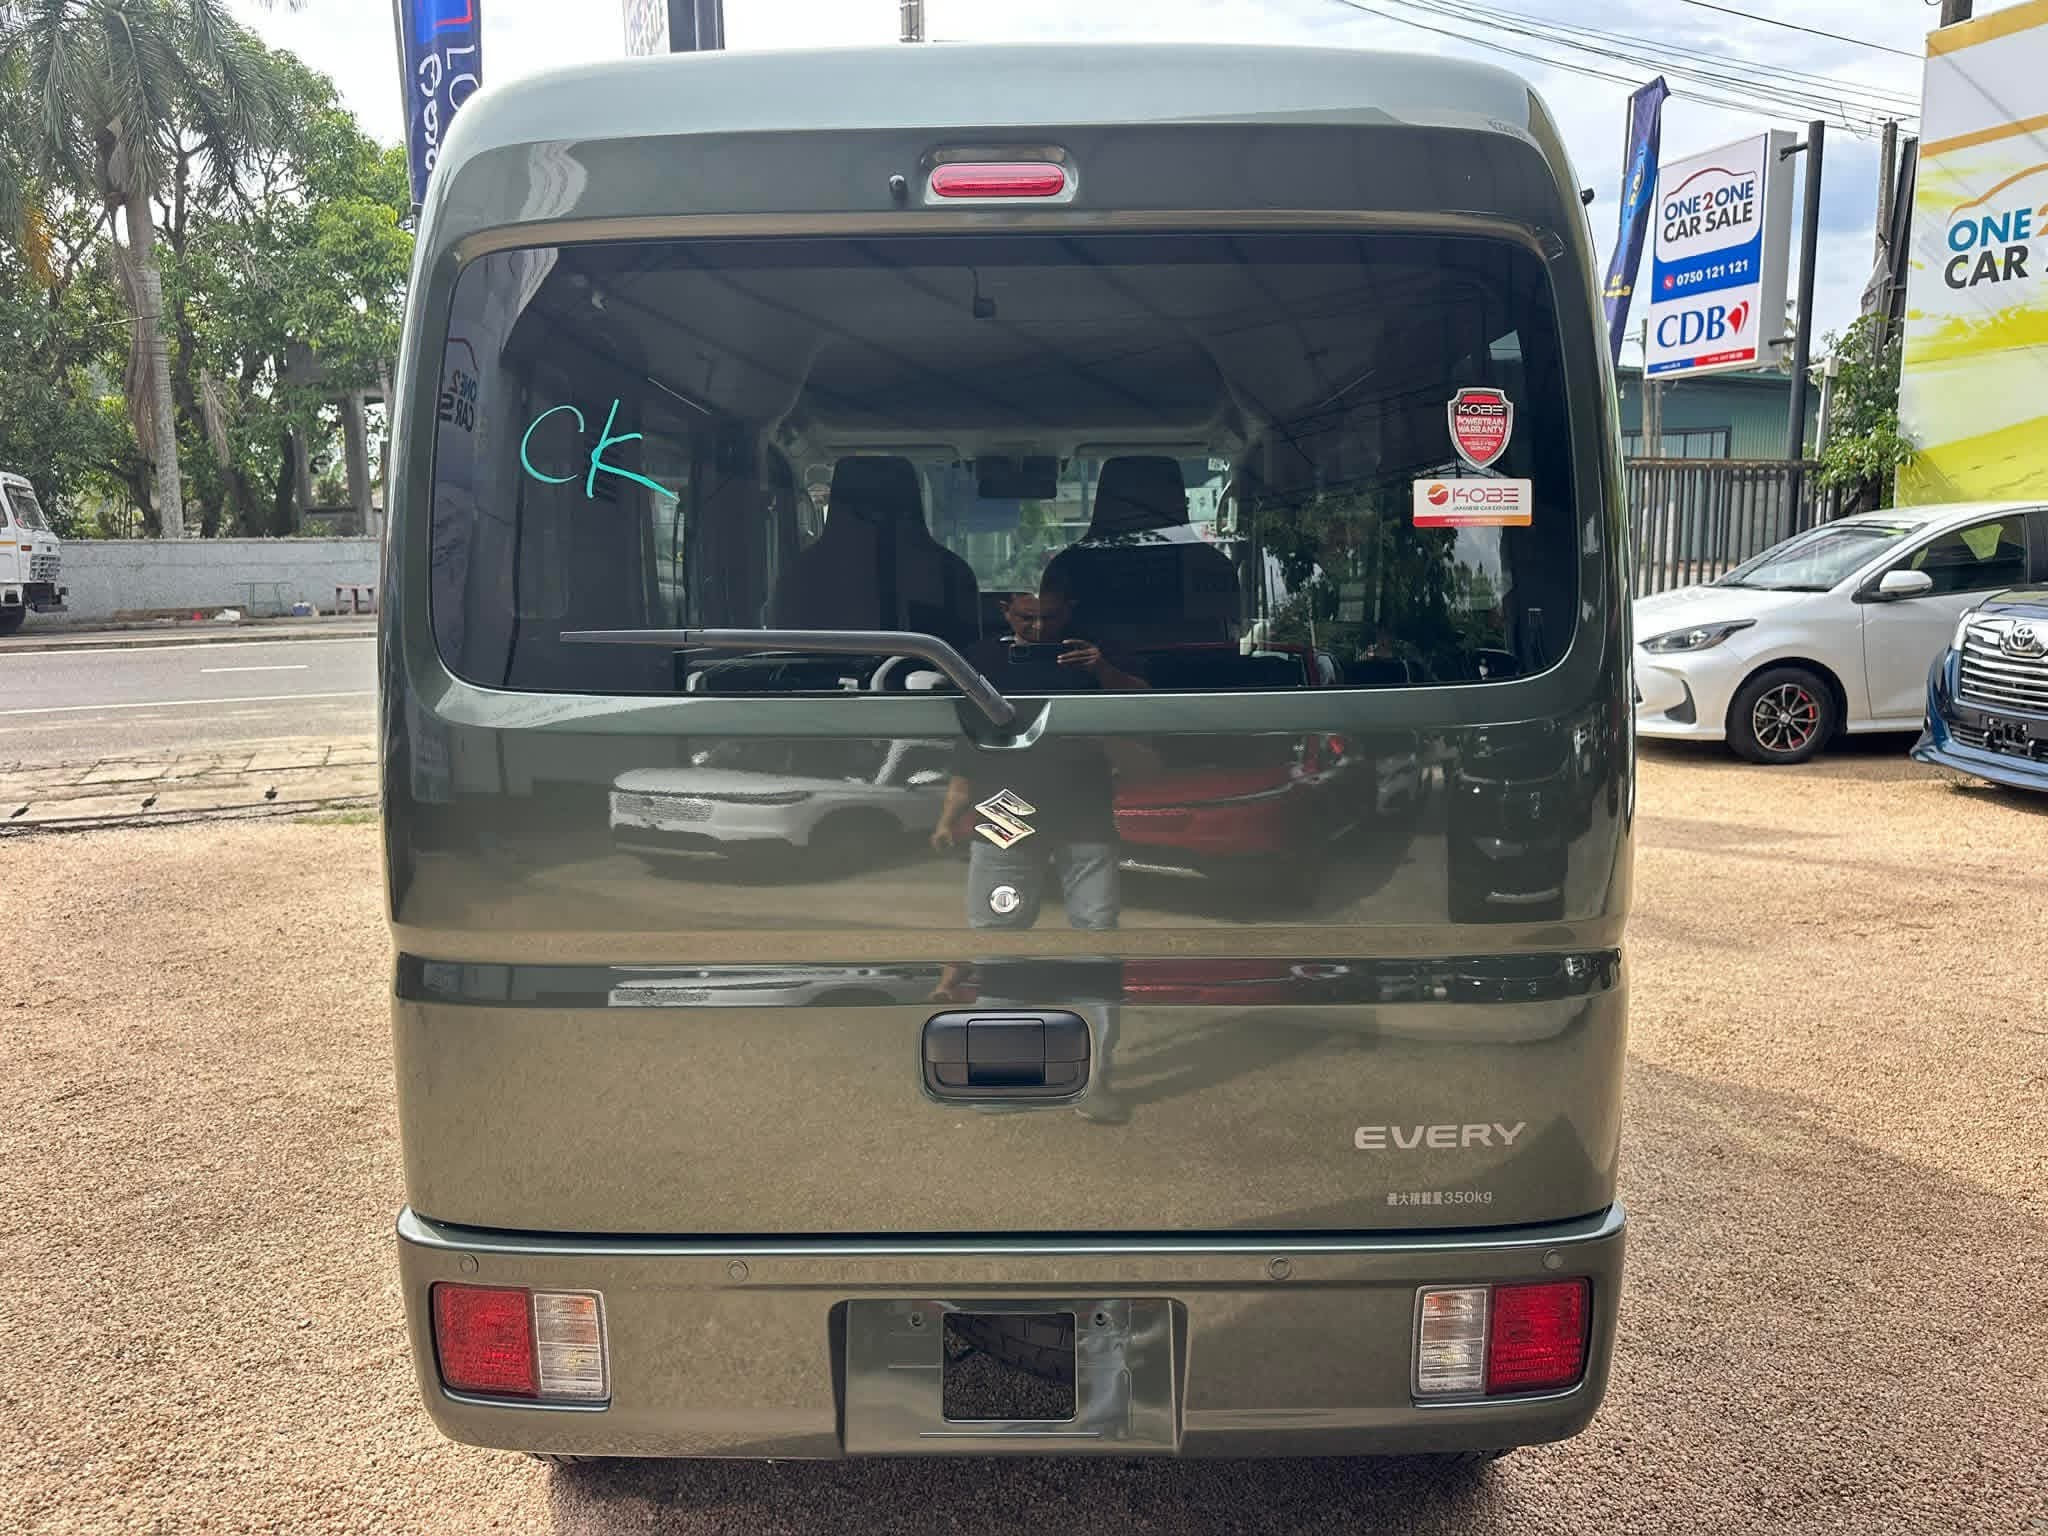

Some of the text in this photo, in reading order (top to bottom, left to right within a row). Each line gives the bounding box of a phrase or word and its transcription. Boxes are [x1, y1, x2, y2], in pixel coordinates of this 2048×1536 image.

[1663, 201, 1754, 244] CAR SALE
[1676, 259, 1750, 288] 0750 121 121
[1944, 245, 2029, 289] CAR
[1656, 305, 1727, 349] CDB
[1456, 416, 1504, 426] POWERTRAIN
[1458, 404, 1504, 415] KOBE
[1457, 424, 1503, 434] WARRANTY
[1452, 487, 1519, 503] KOBE
[1354, 1121, 1527, 1149] EVERY
